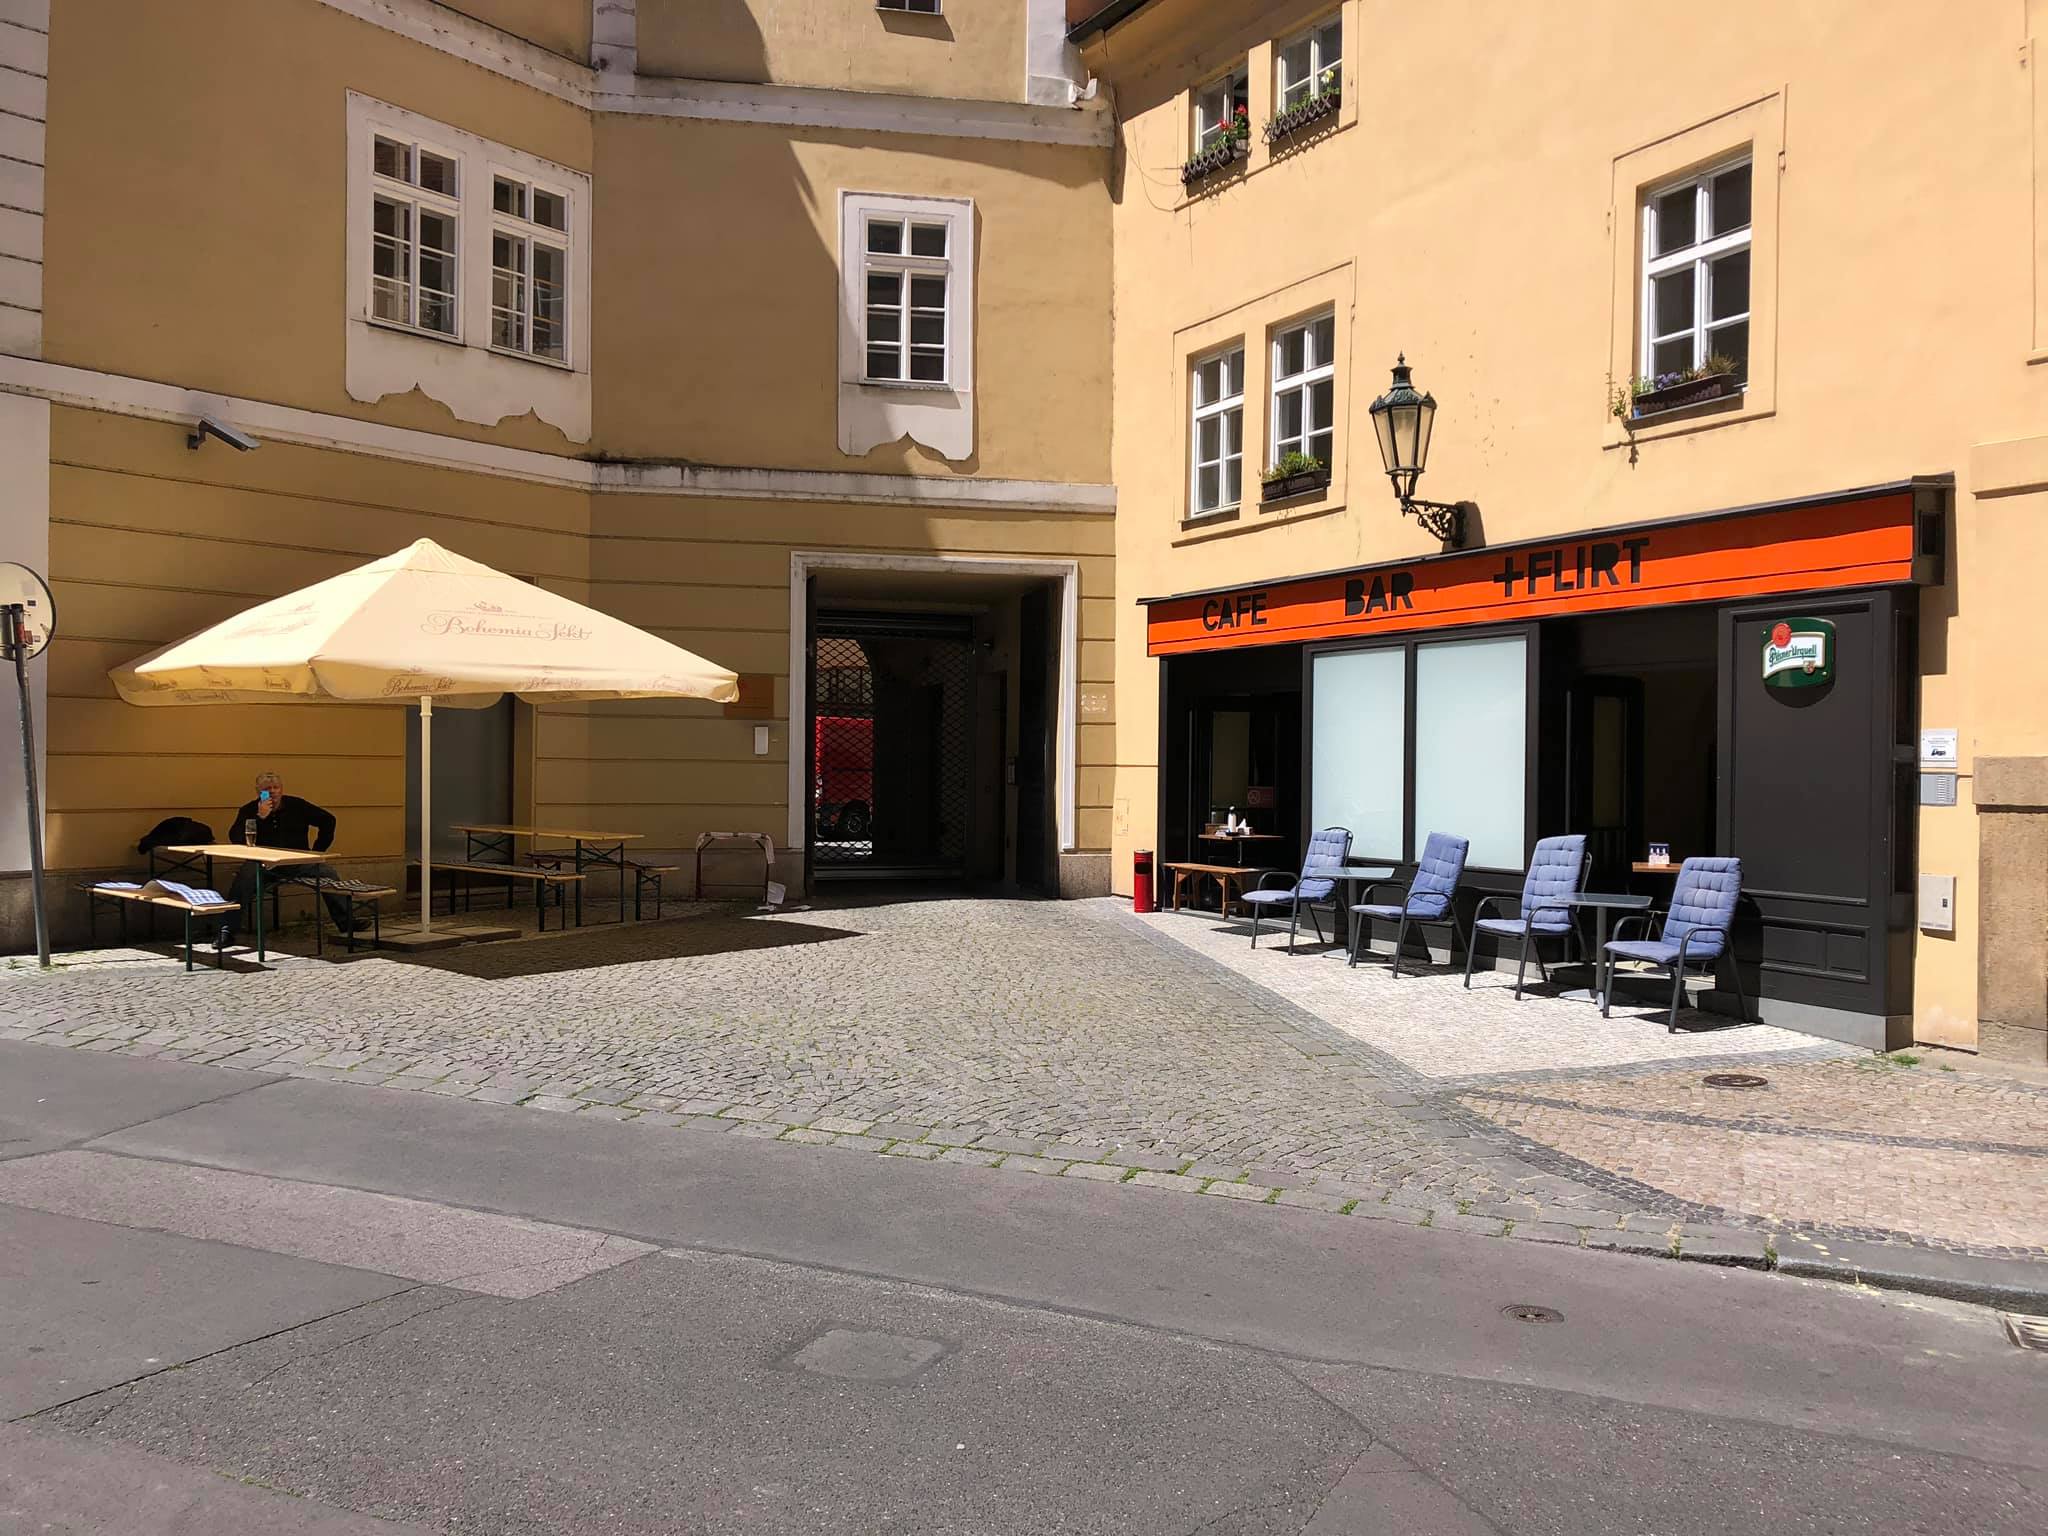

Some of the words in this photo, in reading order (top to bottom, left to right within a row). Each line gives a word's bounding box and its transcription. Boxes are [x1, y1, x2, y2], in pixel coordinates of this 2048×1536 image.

[1202, 592, 1267, 631] CAFE
[1344, 572, 1414, 616] BAR
[420, 614, 532, 638] Bohemia
[535, 623, 592, 641] Sekt
[1769, 647, 1791, 667] Pilsner
[1791, 645, 1817, 659] Urquell
